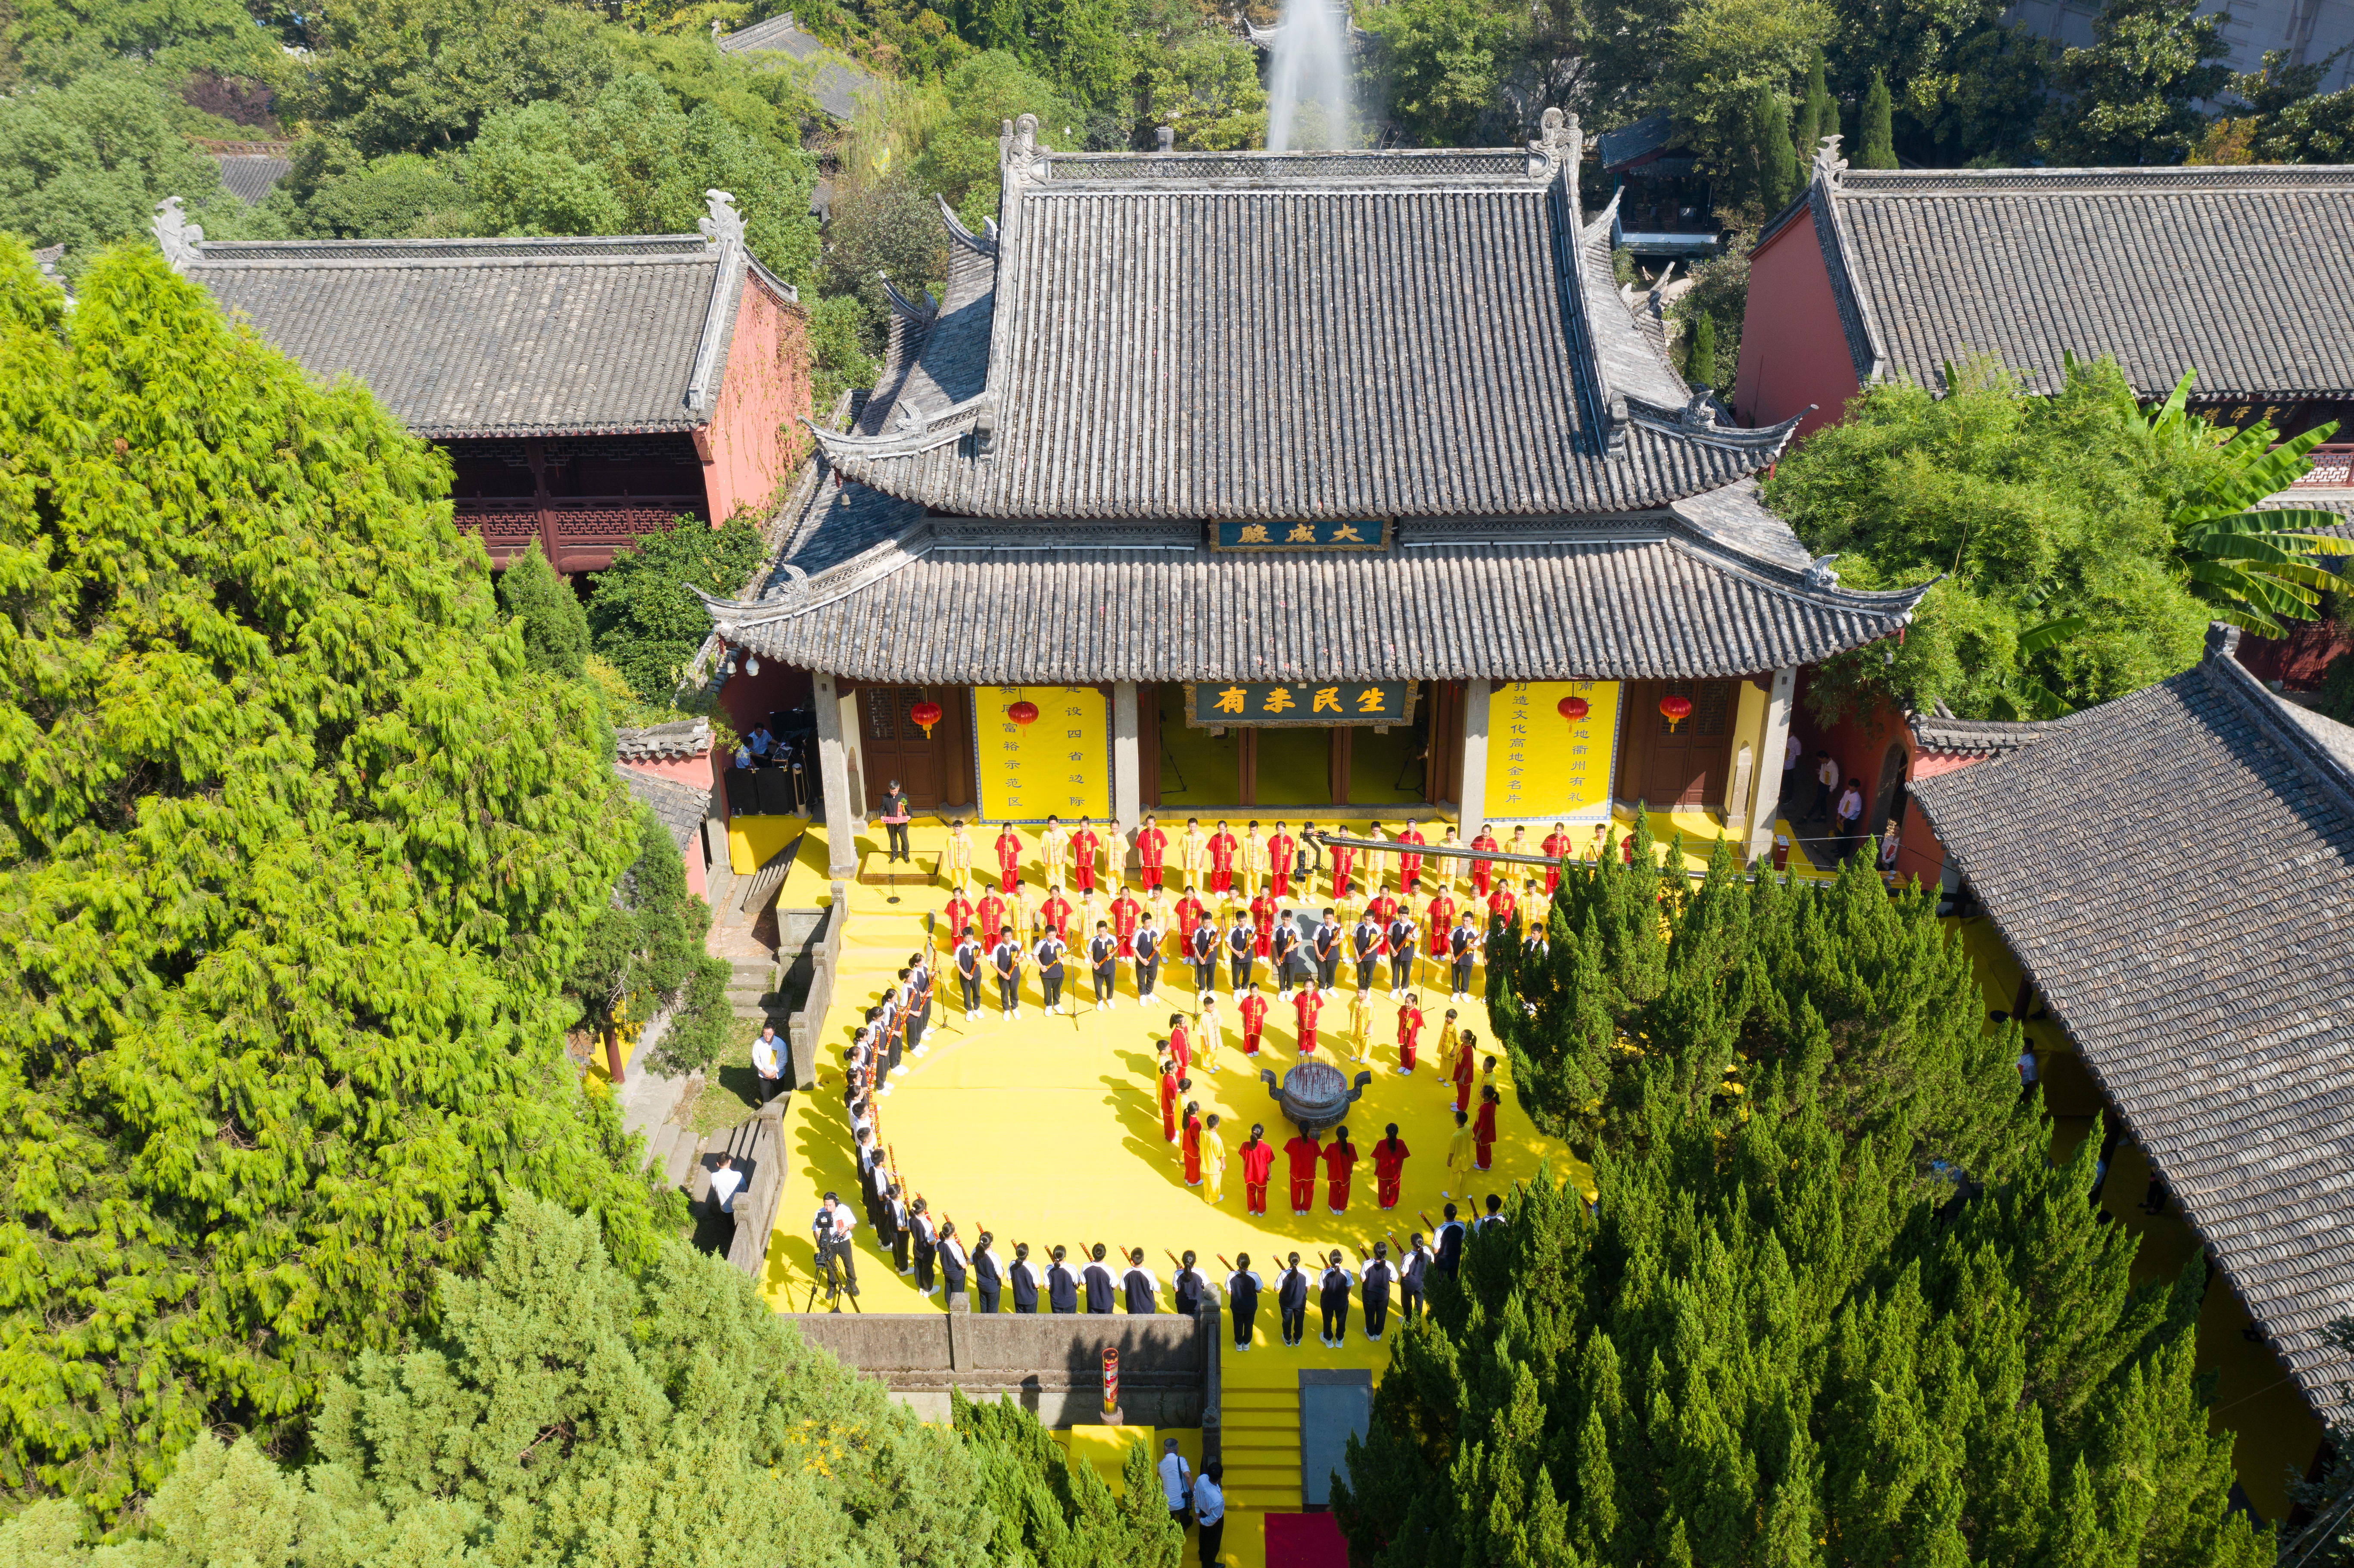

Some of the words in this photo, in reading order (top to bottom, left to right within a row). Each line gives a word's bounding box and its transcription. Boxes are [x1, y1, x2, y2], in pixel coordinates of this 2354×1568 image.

[1237, 523, 1364, 543] 大成殿
[1213, 686, 1385, 713] 生民未有
[1505, 682, 1530, 803] 打造文化高地金名片
